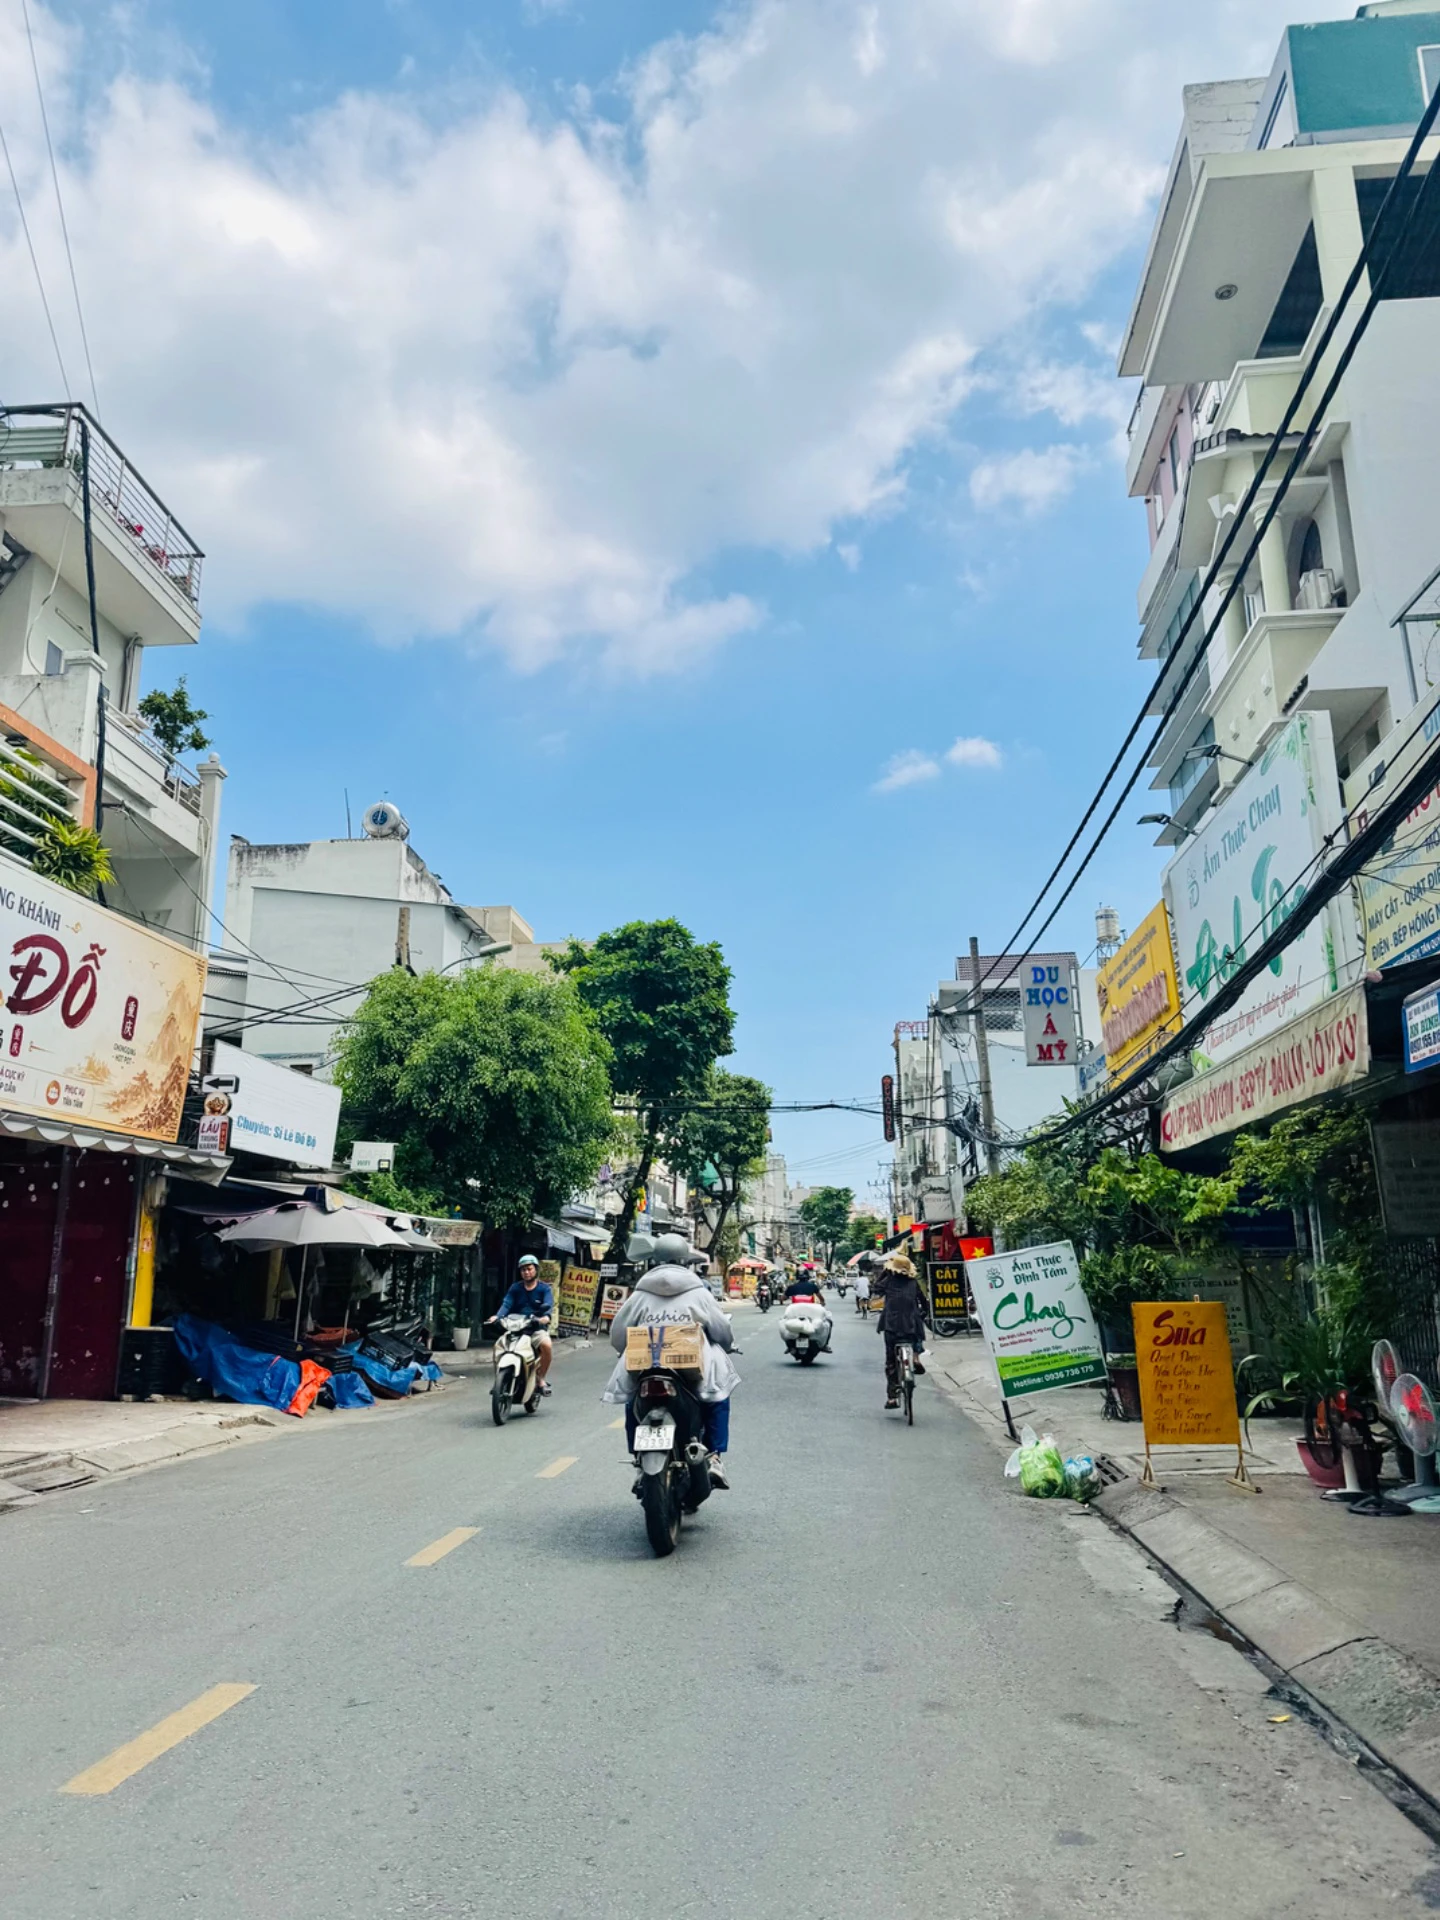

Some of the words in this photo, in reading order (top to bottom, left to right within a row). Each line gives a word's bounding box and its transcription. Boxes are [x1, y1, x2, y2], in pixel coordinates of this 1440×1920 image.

[1220, 818, 1247, 862] Thực
[1249, 783, 1281, 834] Chay
[18, 895, 61, 931] KHÁNH
[1031, 966, 1059, 984] DU
[1026, 987, 1068, 1008] HỌC
[1043, 1012, 1058, 1035] Á
[1036, 1039, 1068, 1061] MỸ
[237, 1115, 272, 1136] Chuyên:
[1035, 1254, 1062, 1267] Thực
[936, 1282, 959, 1294] TÓC
[1013, 1271, 1040, 1286] Định
[935, 1298, 963, 1308] NAM
[993, 1292, 1086, 1339] Chay
[1152, 1310, 1207, 1346] Sửa
[1012, 1375, 1044, 1389] Hotline:
[1081, 1364, 1094, 1375] 179
